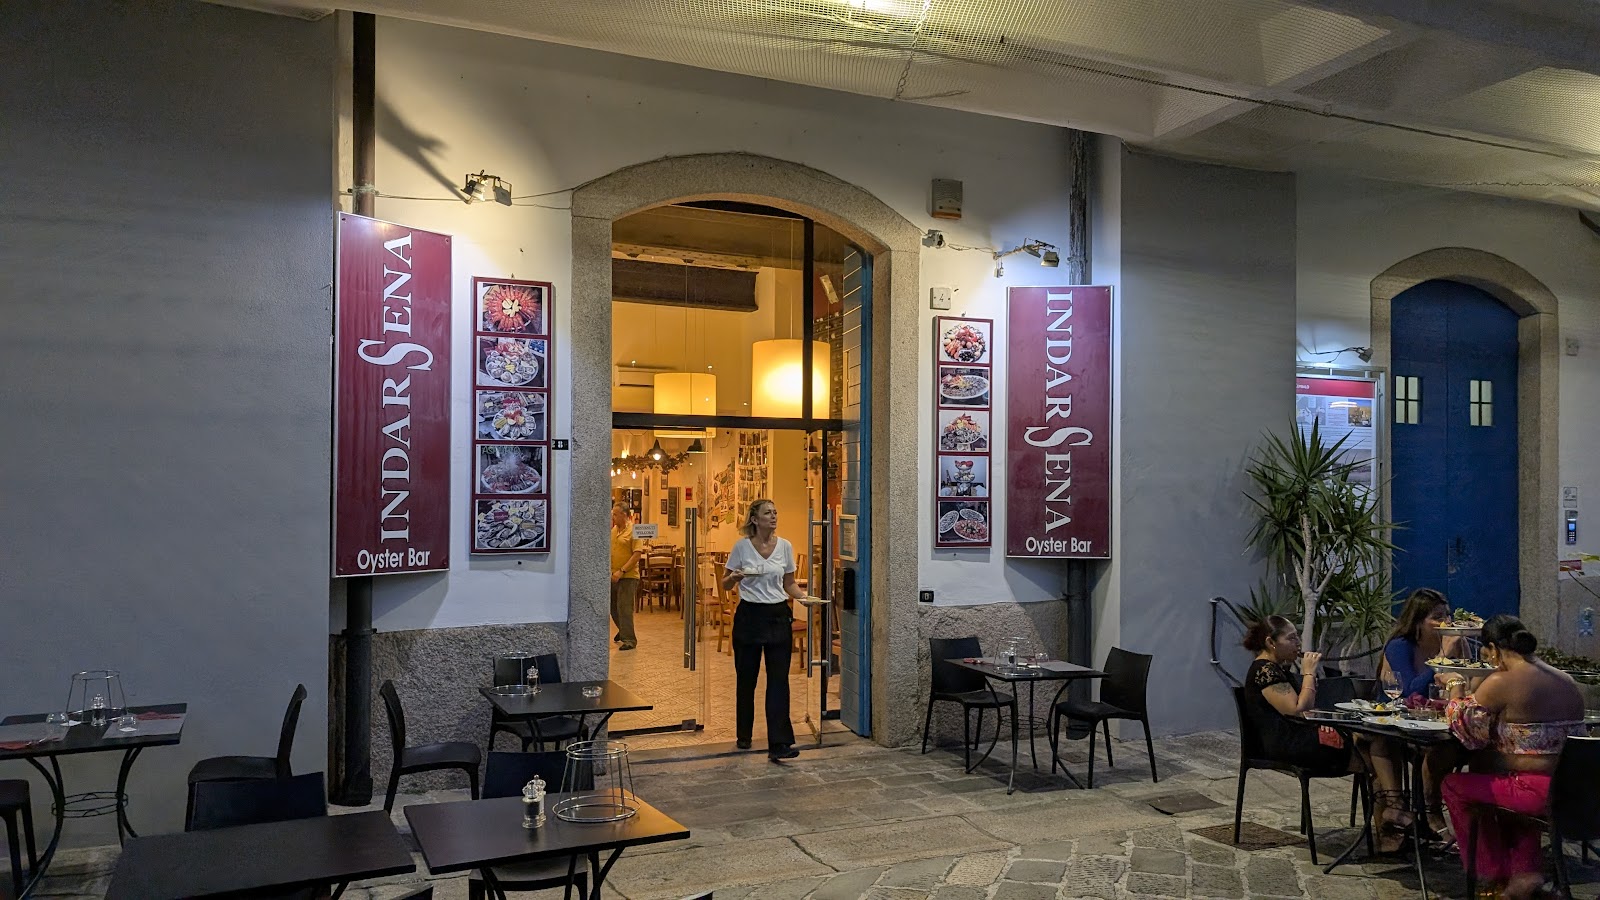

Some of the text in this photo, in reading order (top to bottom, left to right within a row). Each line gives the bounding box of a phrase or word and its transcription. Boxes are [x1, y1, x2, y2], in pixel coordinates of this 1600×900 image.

[357, 232, 434, 543] INDARSENA
[1023, 289, 1094, 534] INDARSENA
[357, 547, 430, 573] Oyster Bar
[1025, 536, 1092, 555] Oyster Bar
